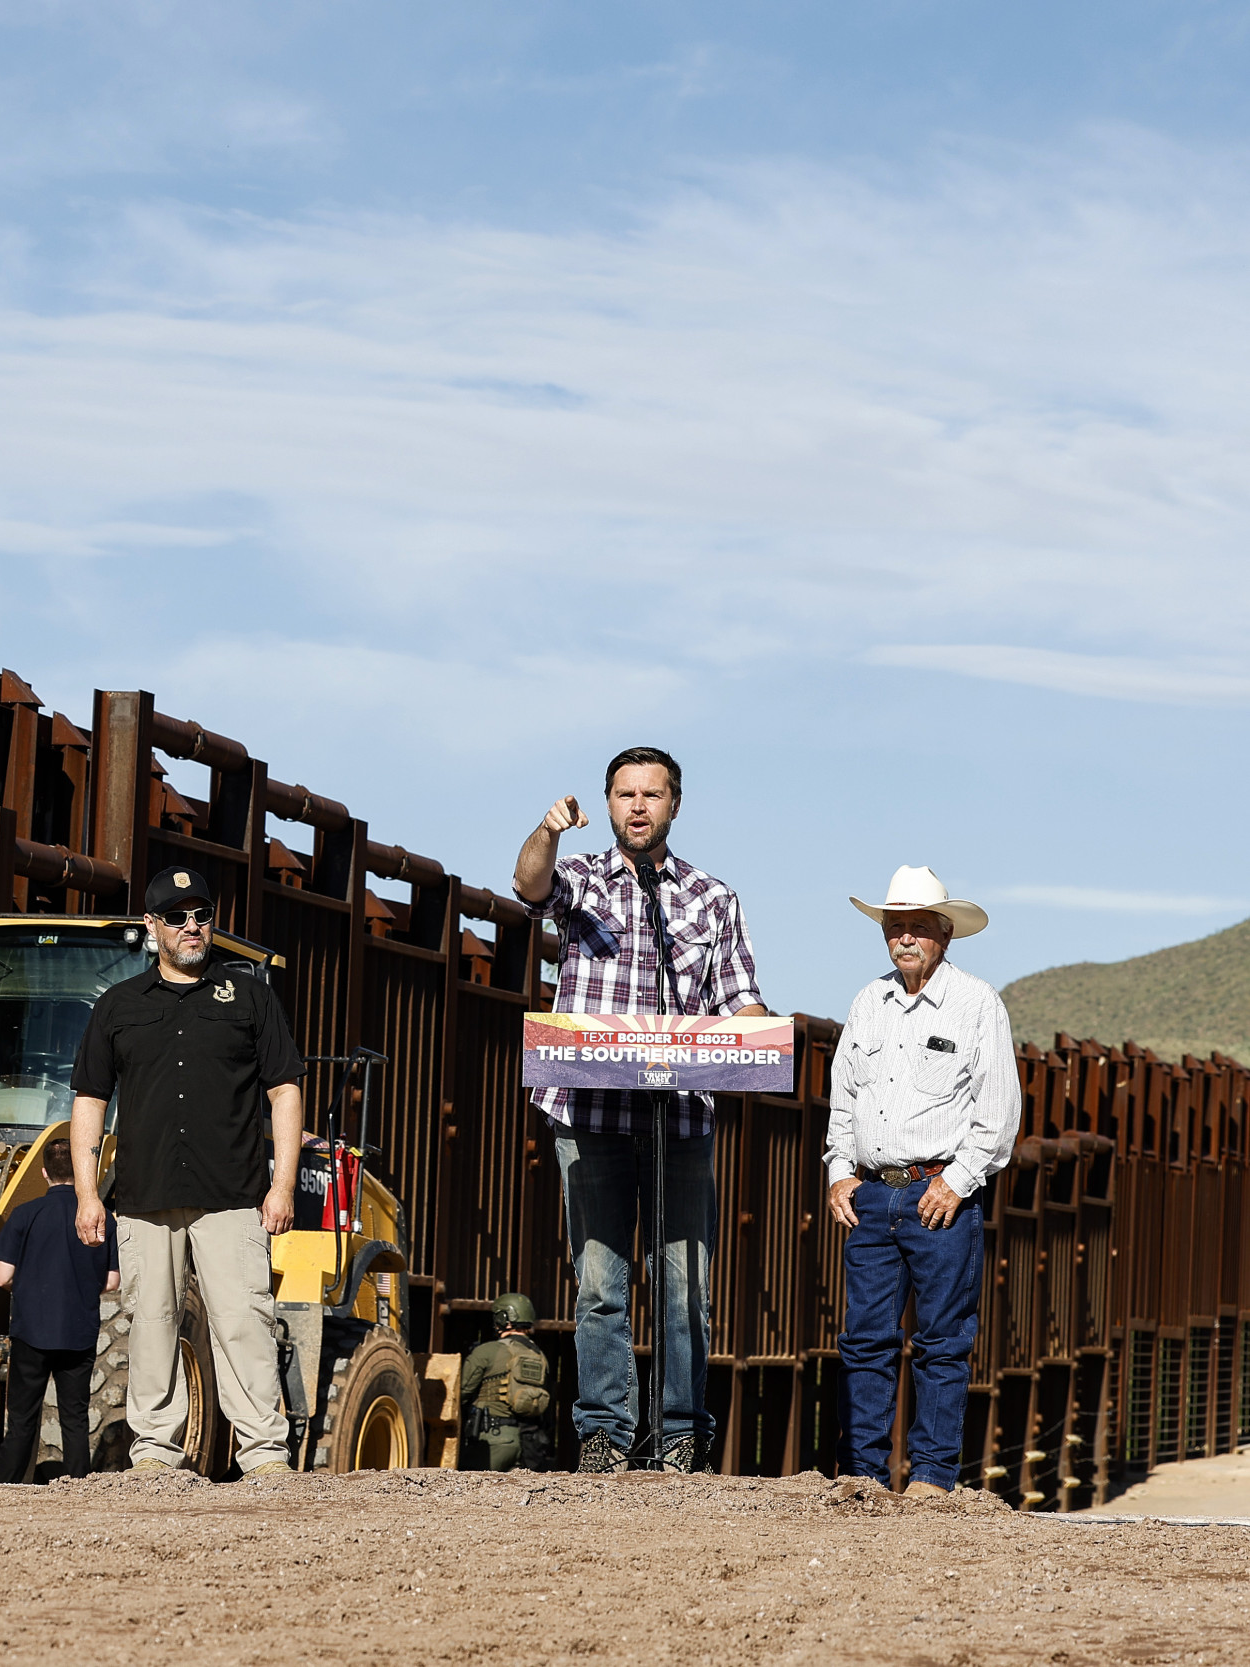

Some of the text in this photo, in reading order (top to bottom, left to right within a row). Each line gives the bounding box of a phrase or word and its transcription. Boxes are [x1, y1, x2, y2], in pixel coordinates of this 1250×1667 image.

[581, 1031, 737, 1045] TEXT BORDER TO 88022
[536, 1045, 781, 1065] THE SOUTHERN BORDER
